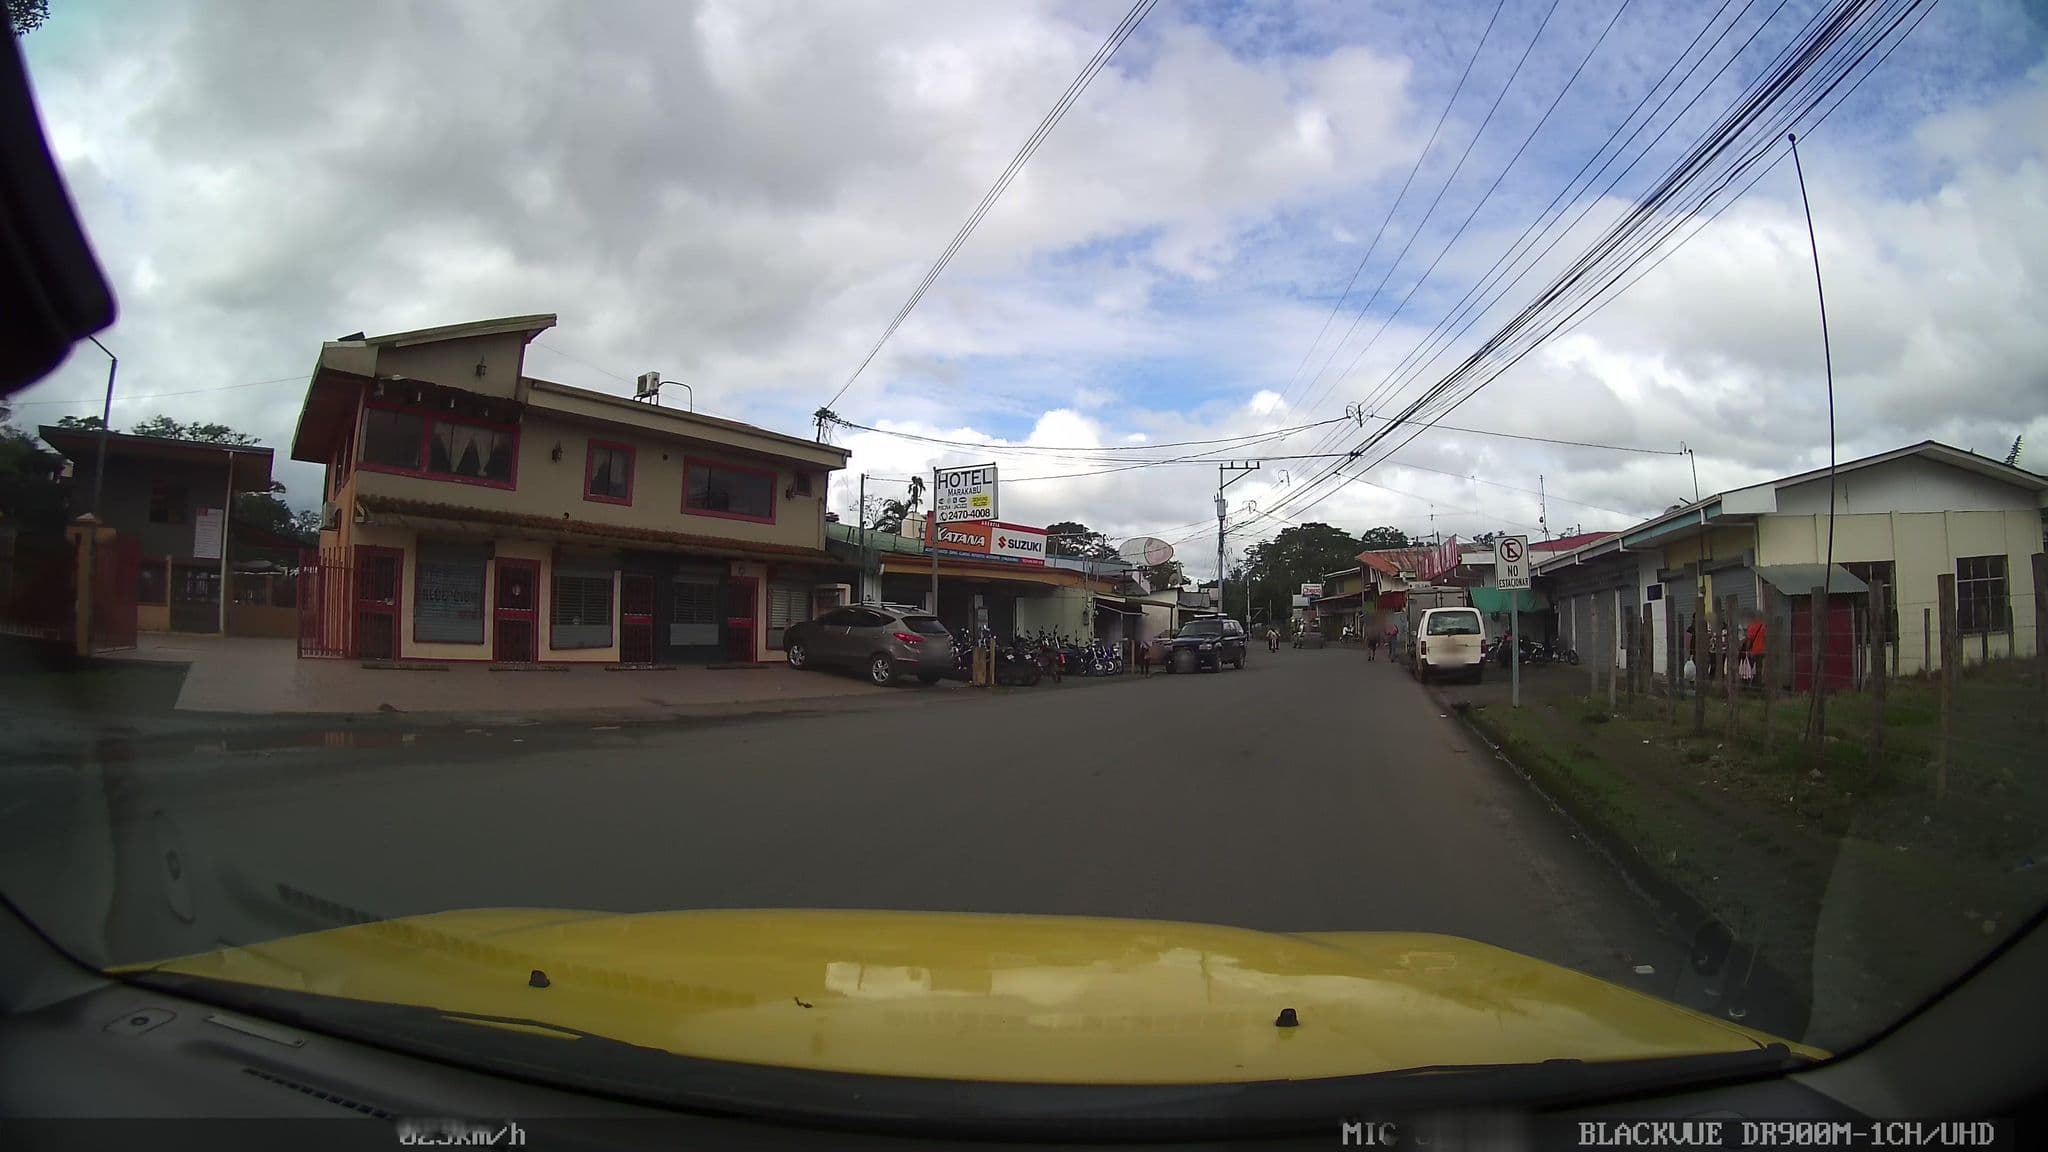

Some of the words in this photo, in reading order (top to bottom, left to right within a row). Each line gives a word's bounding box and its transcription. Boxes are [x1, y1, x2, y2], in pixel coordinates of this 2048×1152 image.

[938, 469, 992, 489] HOTEL
[948, 509, 990, 520] 2470-4008
[1008, 539, 1041, 552] SUZUKI
[1507, 565, 1518, 577] NO
[1499, 578, 1528, 588] ESTACIONAR
